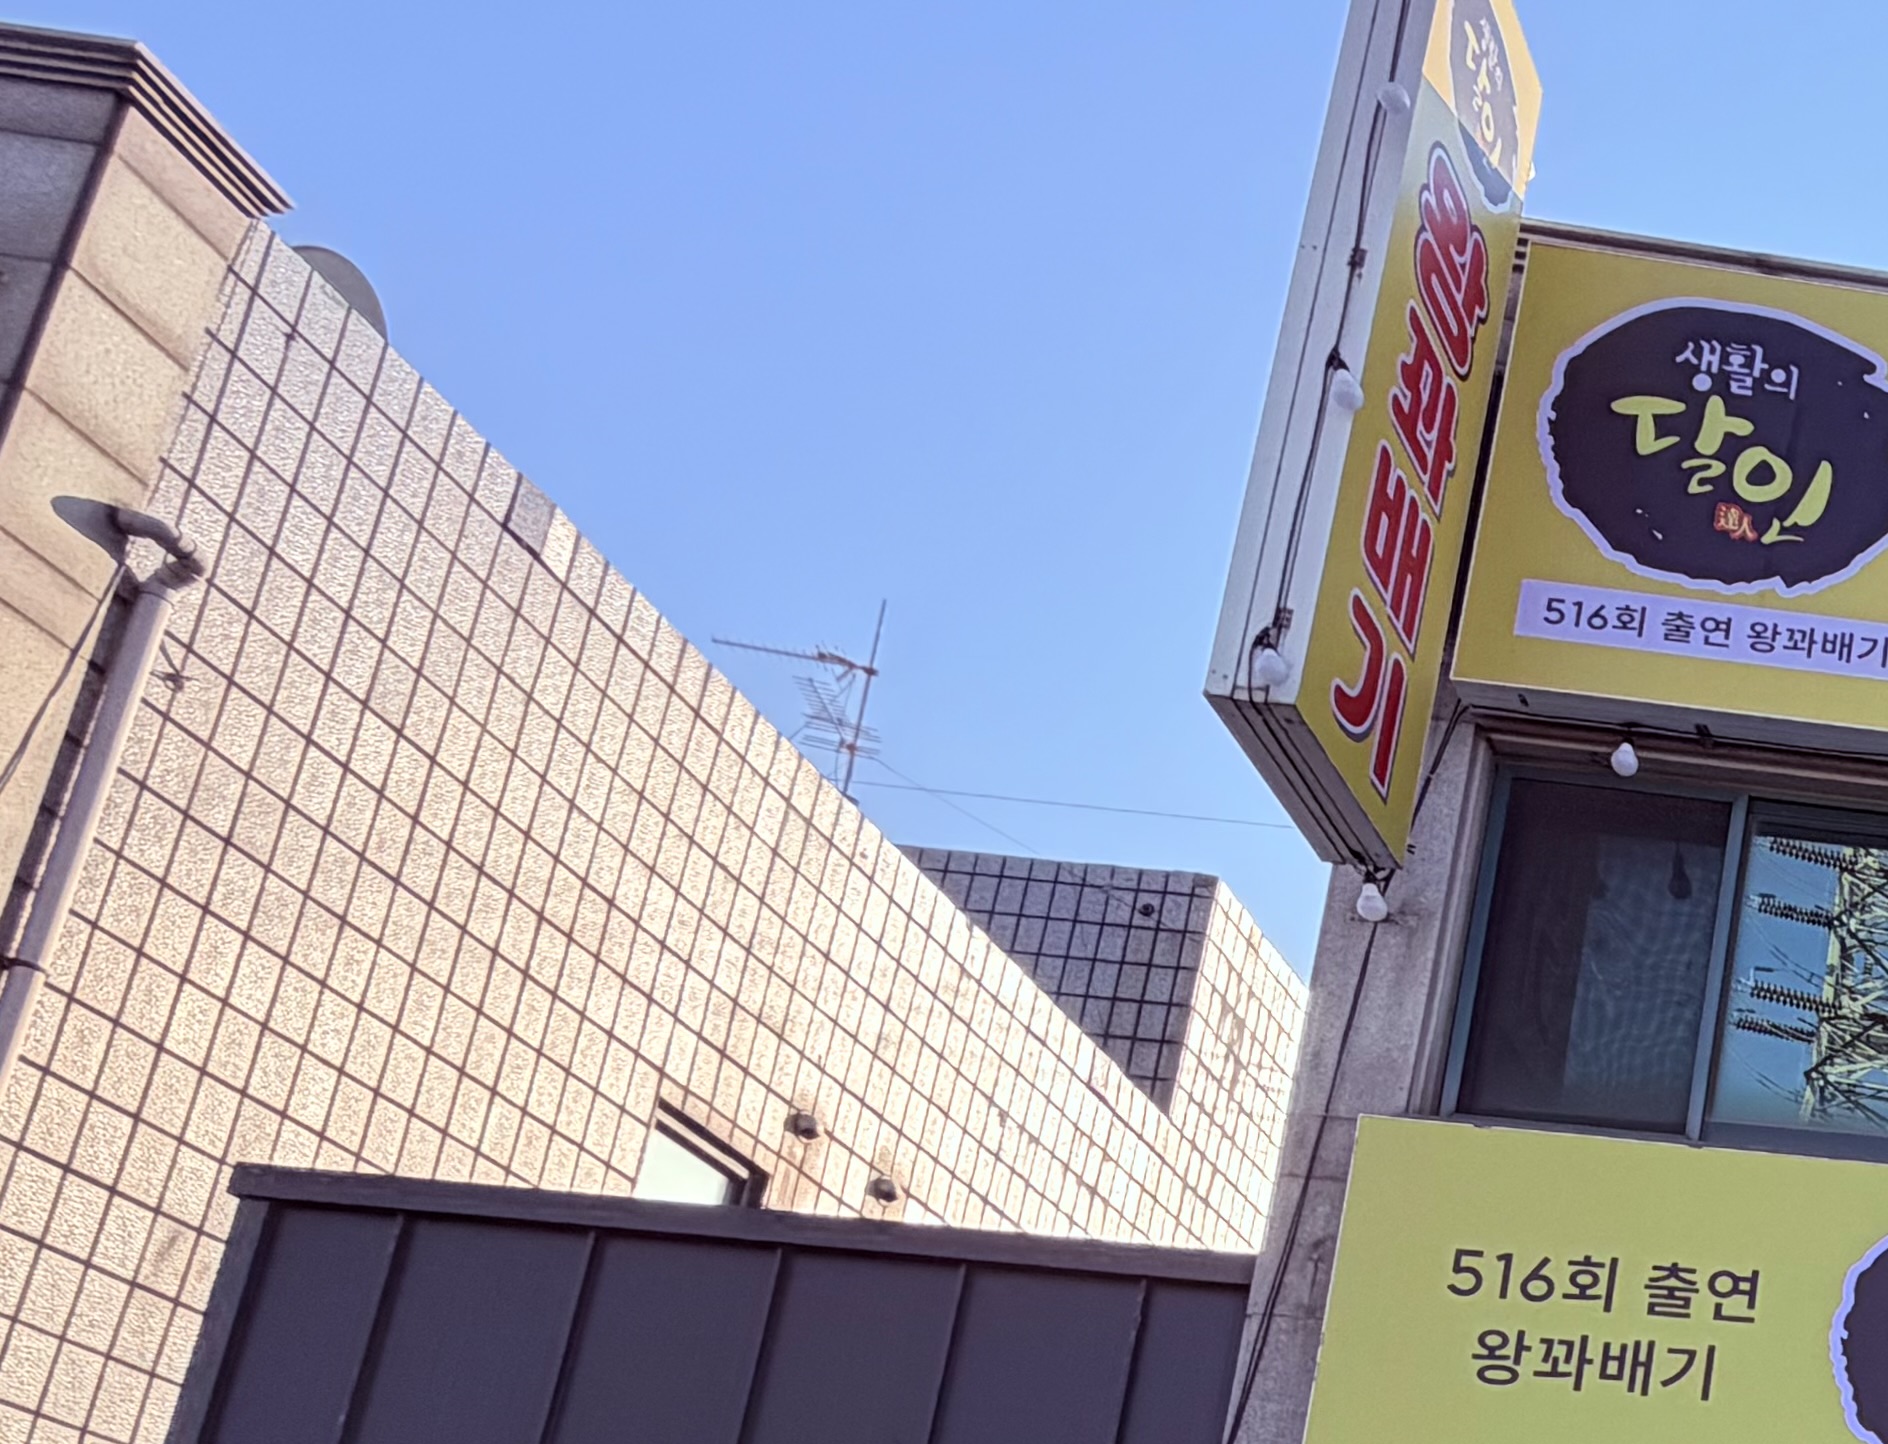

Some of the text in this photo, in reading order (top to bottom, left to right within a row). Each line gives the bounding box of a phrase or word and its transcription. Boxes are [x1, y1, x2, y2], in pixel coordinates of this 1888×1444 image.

[1675, 339, 1800, 400] 생활의
[1610, 394, 1833, 545] 달인
[1542, 596, 1648, 640] 516회
[1661, 610, 1732, 651] 출연
[1446, 1247, 1760, 1325] 516회 출연
[1470, 1328, 1717, 1401] 왕꽈배기
